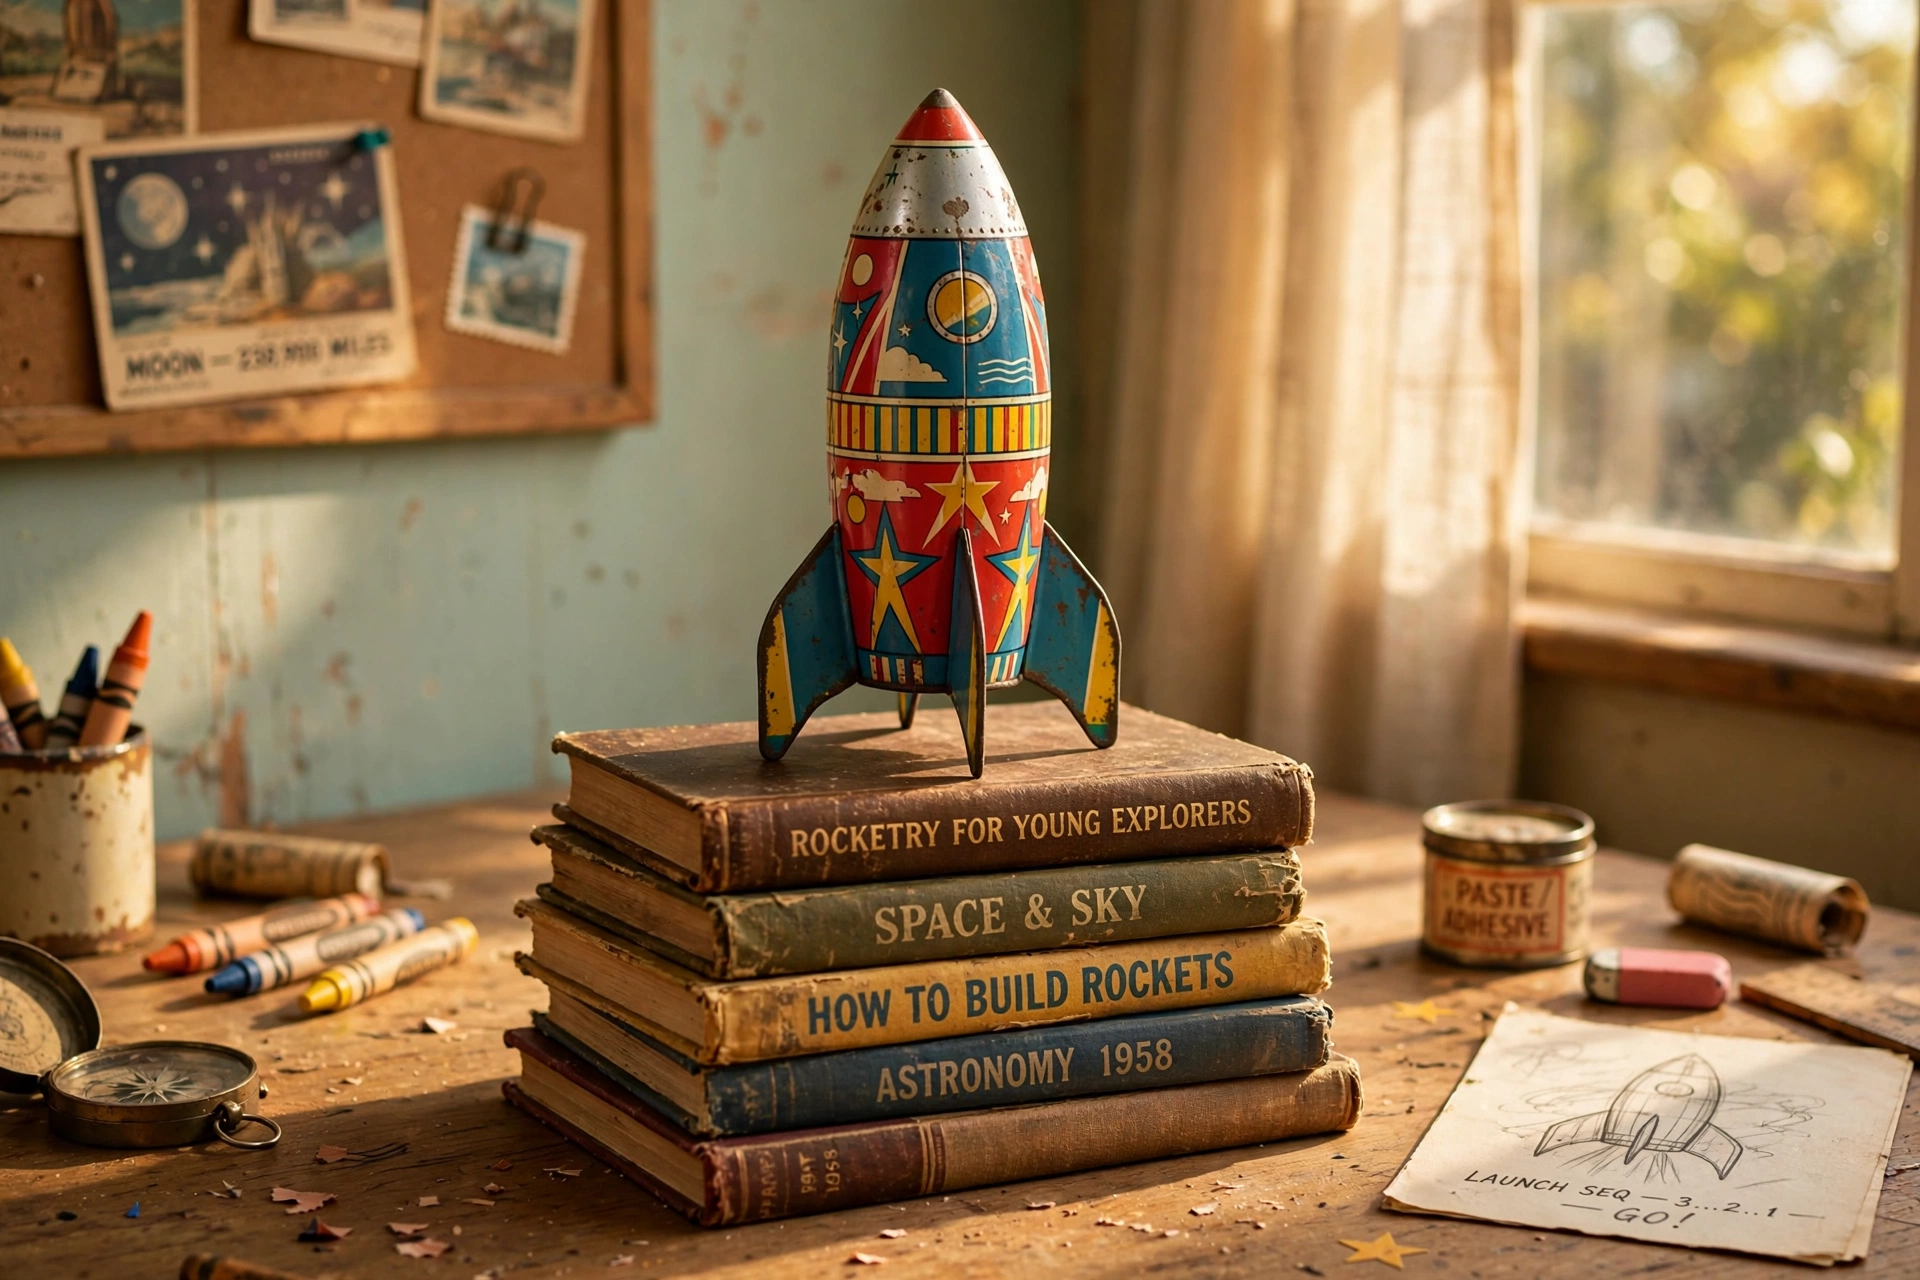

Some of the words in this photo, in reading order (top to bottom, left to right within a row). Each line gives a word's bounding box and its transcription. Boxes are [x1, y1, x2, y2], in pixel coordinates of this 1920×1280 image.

[126, 352, 204, 380] MOON
[791, 821, 941, 858] ROCKETRY
[953, 817, 1003, 845] FOR
[1014, 810, 1101, 840] YOUNG
[1112, 799, 1252, 834] EXPLORERS
[875, 898, 1006, 945] SPACE
[1024, 894, 1053, 930] &
[1071, 884, 1148, 926] SKY
[1443, 907, 1551, 939] ADHESIVE
[808, 989, 892, 1036] HOW
[905, 983, 950, 1023] TO
[966, 970, 1068, 1018] BUILD
[1082, 951, 1235, 1005] ROCKETS
[876, 1047, 1075, 1103] ASTRONOMY
[1101, 1038, 1174, 1077] 1958
[1464, 1170, 1569, 1194] LAUNCH
[1579, 1185, 1631, 1203] SEQ
[1613, 1207, 1697, 1229] GO!
